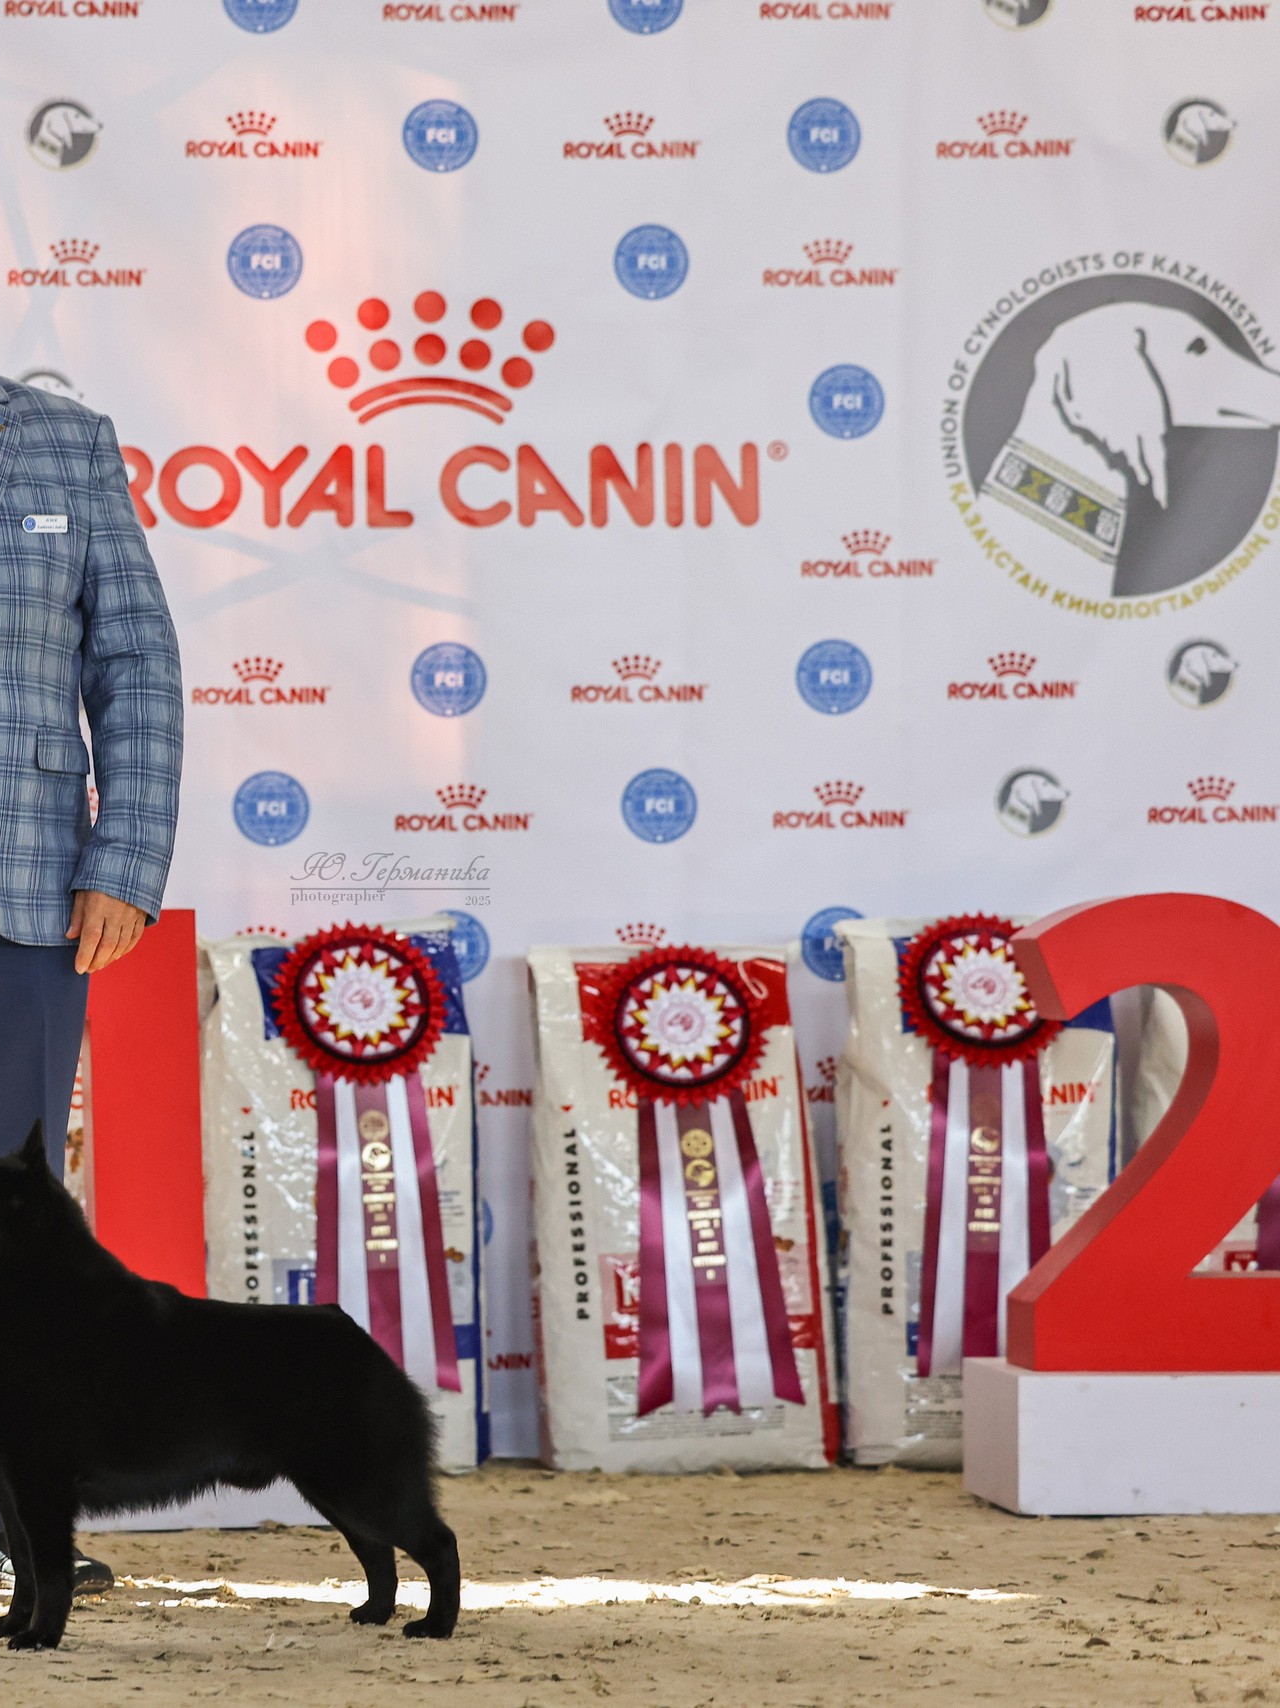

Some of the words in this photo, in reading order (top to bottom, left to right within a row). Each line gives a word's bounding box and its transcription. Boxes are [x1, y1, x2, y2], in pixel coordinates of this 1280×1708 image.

[3, 0, 68, 18] ROYAL
[72, 0, 140, 18] CANIN
[382, 3, 445, 23] ROYAL
[449, 3, 517, 23] CANIN
[759, 1, 822, 20] ROYAL
[827, 1, 892, 20] CANIN
[1133, 4, 1196, 23] ROYAL
[1200, 4, 1270, 23] CANIN
[426, 127, 456, 144] FCI
[810, 127, 839, 144] FCI
[184, 140, 249, 159] ROYAL
[253, 140, 319, 159] CANIN
[562, 141, 626, 160] ROYAL
[630, 141, 698, 160] CANIN
[936, 139, 999, 159] ROYAL
[1004, 139, 1072, 159] CANIN
[250, 253, 281, 270] FCI
[637, 253, 667, 270] FCI
[1112, 250, 1146, 271] OF
[6, 268, 71, 288] ROYAL
[75, 268, 143, 288] CANIN
[762, 268, 824, 288] ROYAL
[829, 268, 897, 288] CANIN
[963, 252, 1106, 357] CYNOLOGISTS
[1151, 253, 1277, 356] KAZAKHSTAN
[947, 357, 970, 392] OF
[832, 393, 863, 410] FCI
[939, 397, 962, 480] UNION
[120, 441, 415, 530] ROYAL
[438, 440, 761, 530] CANIN
[801, 558, 863, 578] ROYAL
[868, 558, 934, 578] CANIN
[434, 670, 464, 688] FCI
[819, 669, 850, 685] FCI
[191, 686, 256, 705] ROYAL
[260, 686, 327, 705] CANIN
[571, 684, 633, 703] ROYAL
[638, 684, 705, 703] CANIN
[947, 680, 1009, 700] ROYAL
[1013, 680, 1076, 700] CANIN
[257, 800, 287, 817] FCI
[645, 797, 675, 814] FCI
[1147, 804, 1208, 824] ROYAL
[1212, 804, 1277, 824] CANIN
[394, 813, 458, 832] ROYAL
[462, 813, 531, 832] CANIN
[772, 809, 835, 829] ROYAL
[840, 809, 906, 829] CANIN
[479, 1088, 534, 1107] ANIN
[563, 1128, 590, 1321] PROFESSIONAL
[880, 1123, 895, 1317] PROFESSIONAL
